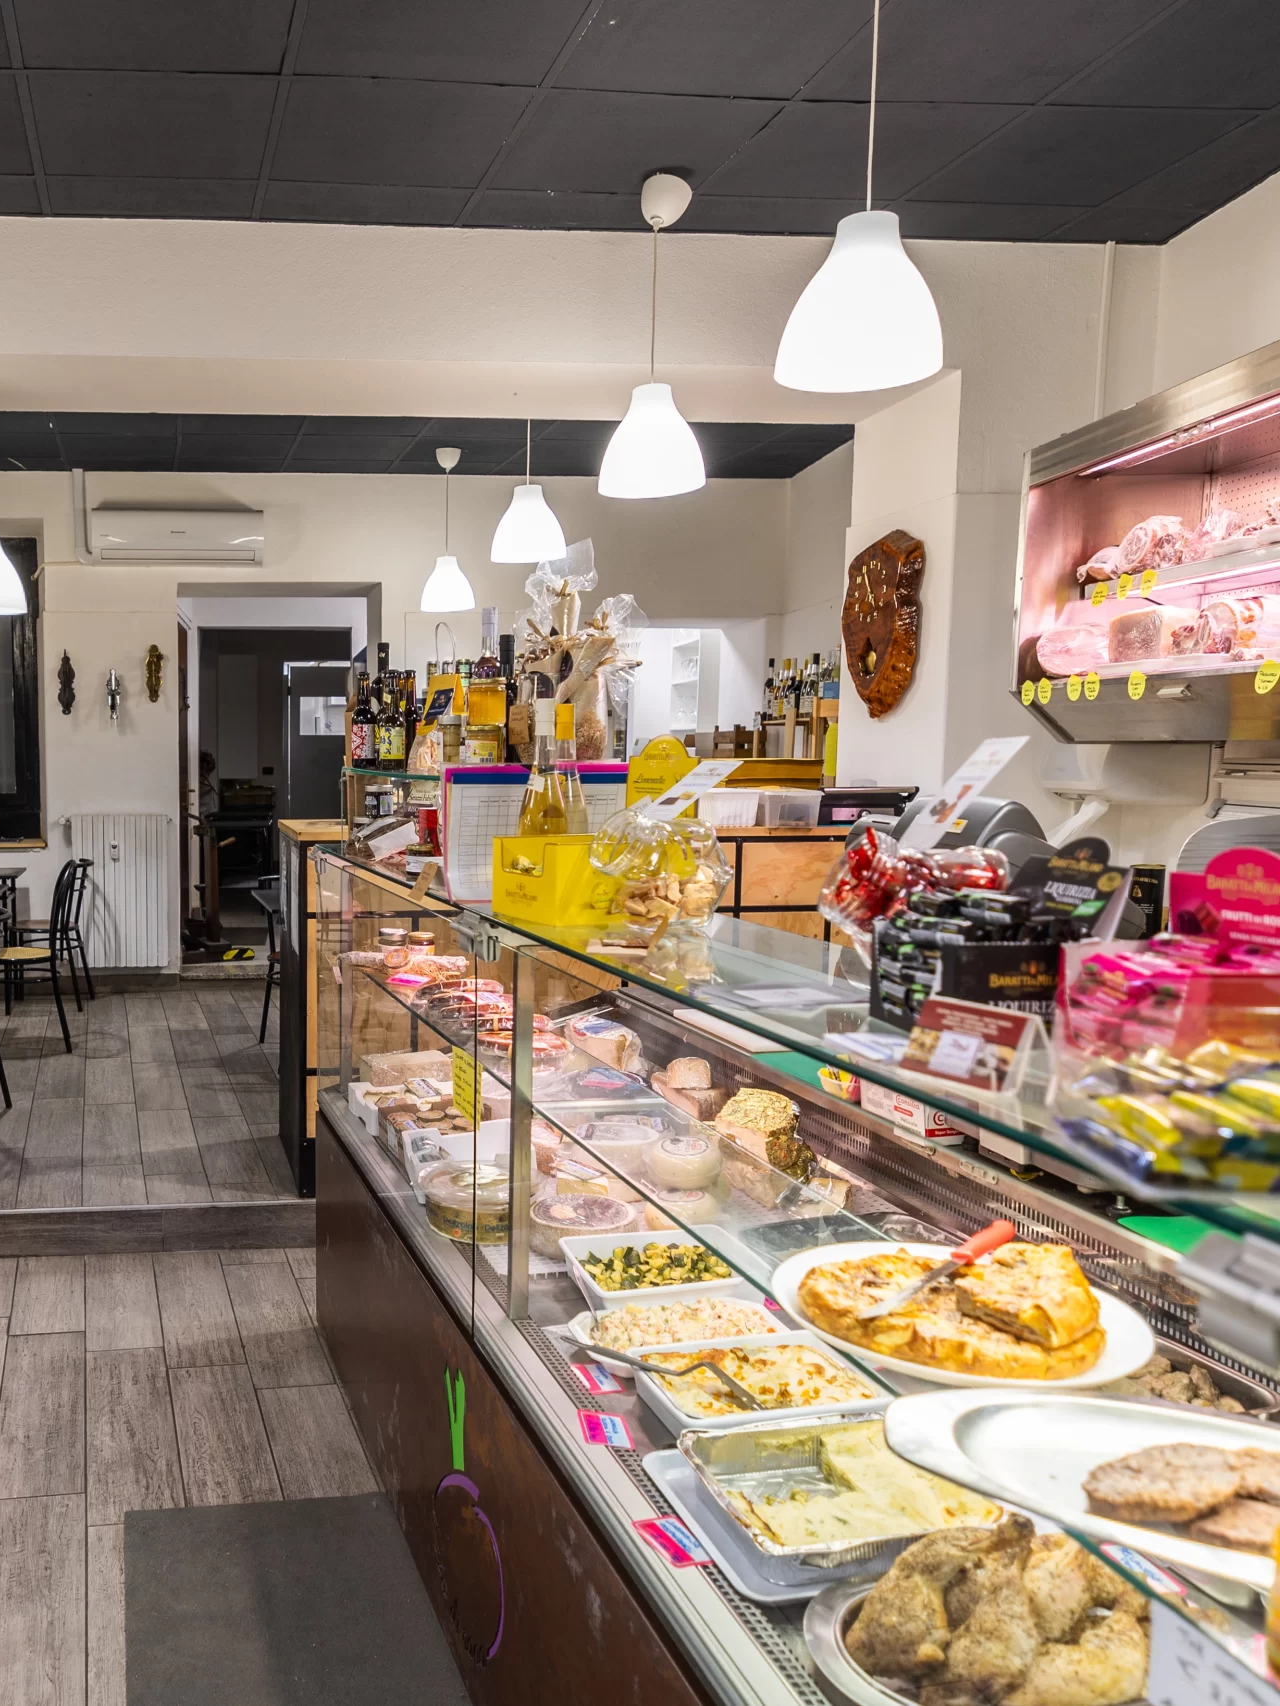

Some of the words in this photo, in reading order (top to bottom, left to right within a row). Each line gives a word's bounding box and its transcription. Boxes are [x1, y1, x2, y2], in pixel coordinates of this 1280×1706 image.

[1221, 908, 1252, 922] FRUTTI
[1262, 913, 1280, 927] BOS
[988, 973, 1030, 989] BARATTI
